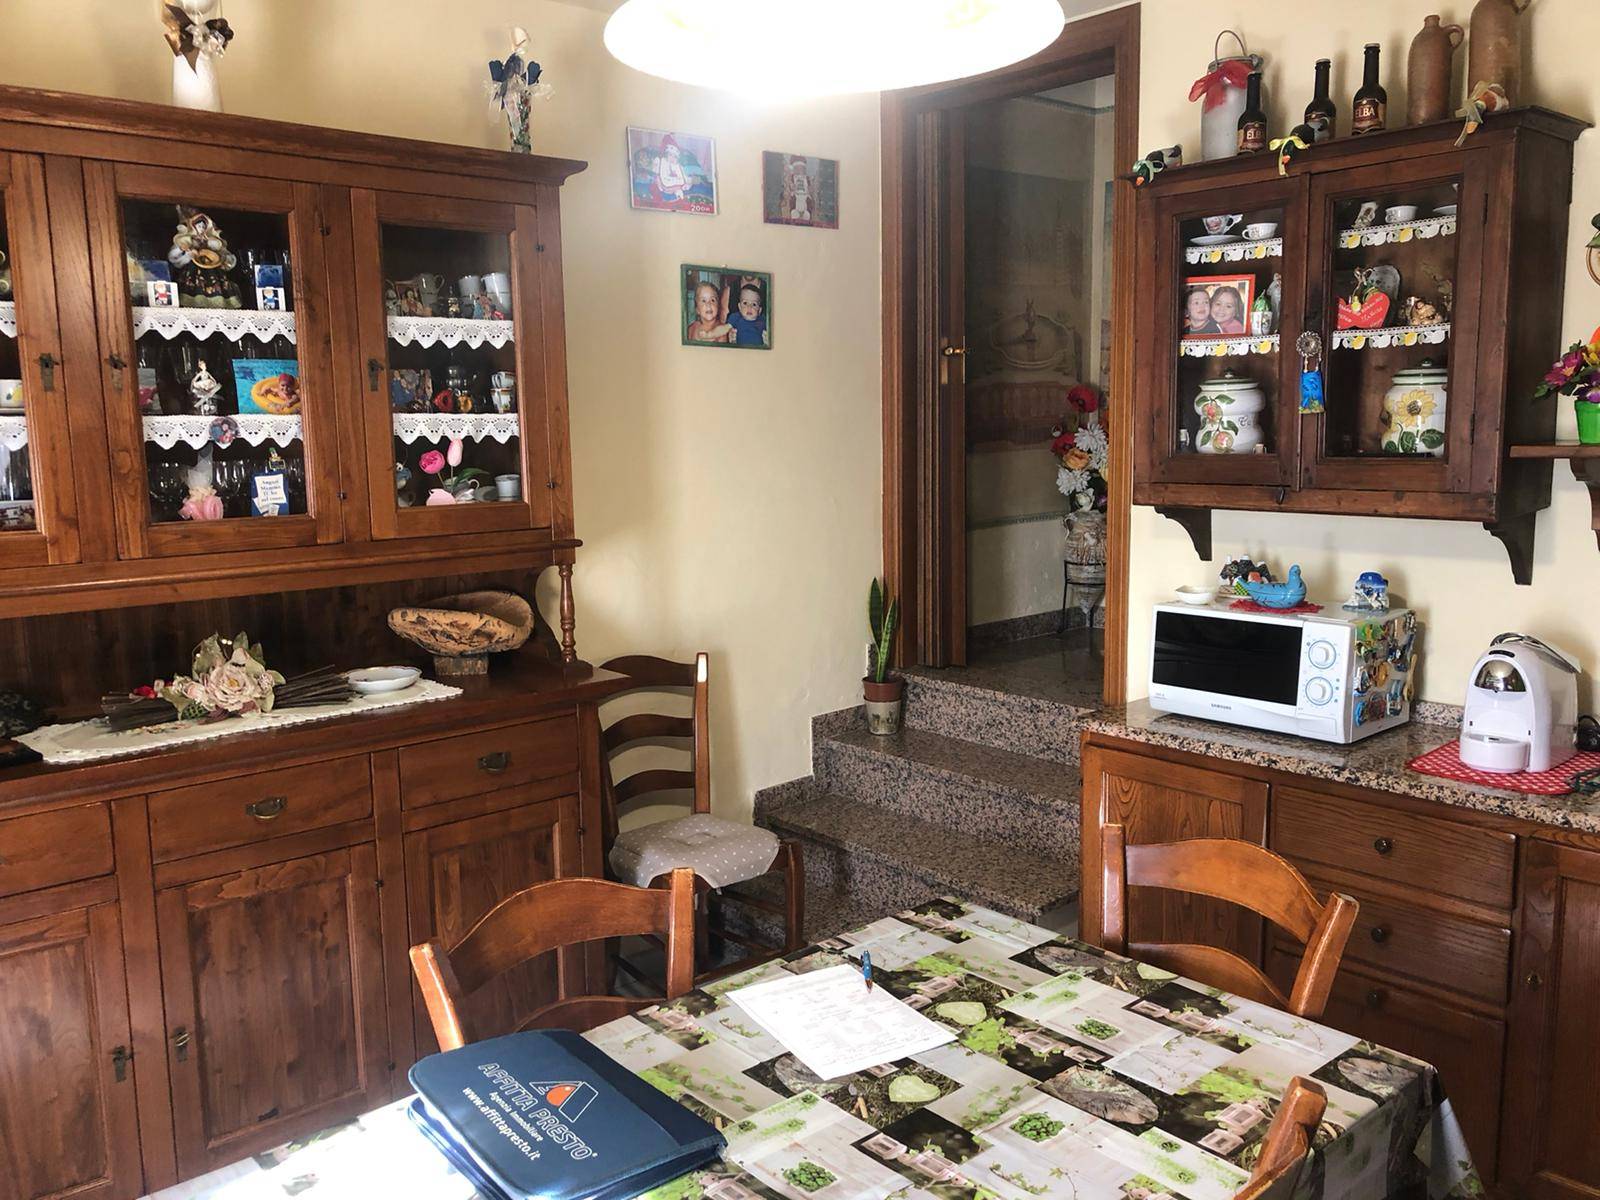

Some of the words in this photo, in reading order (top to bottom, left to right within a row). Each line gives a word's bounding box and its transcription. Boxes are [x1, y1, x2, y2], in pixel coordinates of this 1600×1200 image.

[1355, 106, 1376, 117] ELBA
[462, 1087, 541, 1161] www.affittapresto.it
[478, 1062, 539, 1112] AFFITTA
[528, 1107, 593, 1160] PRESTO
[488, 1091, 513, 1114] Agenzia
